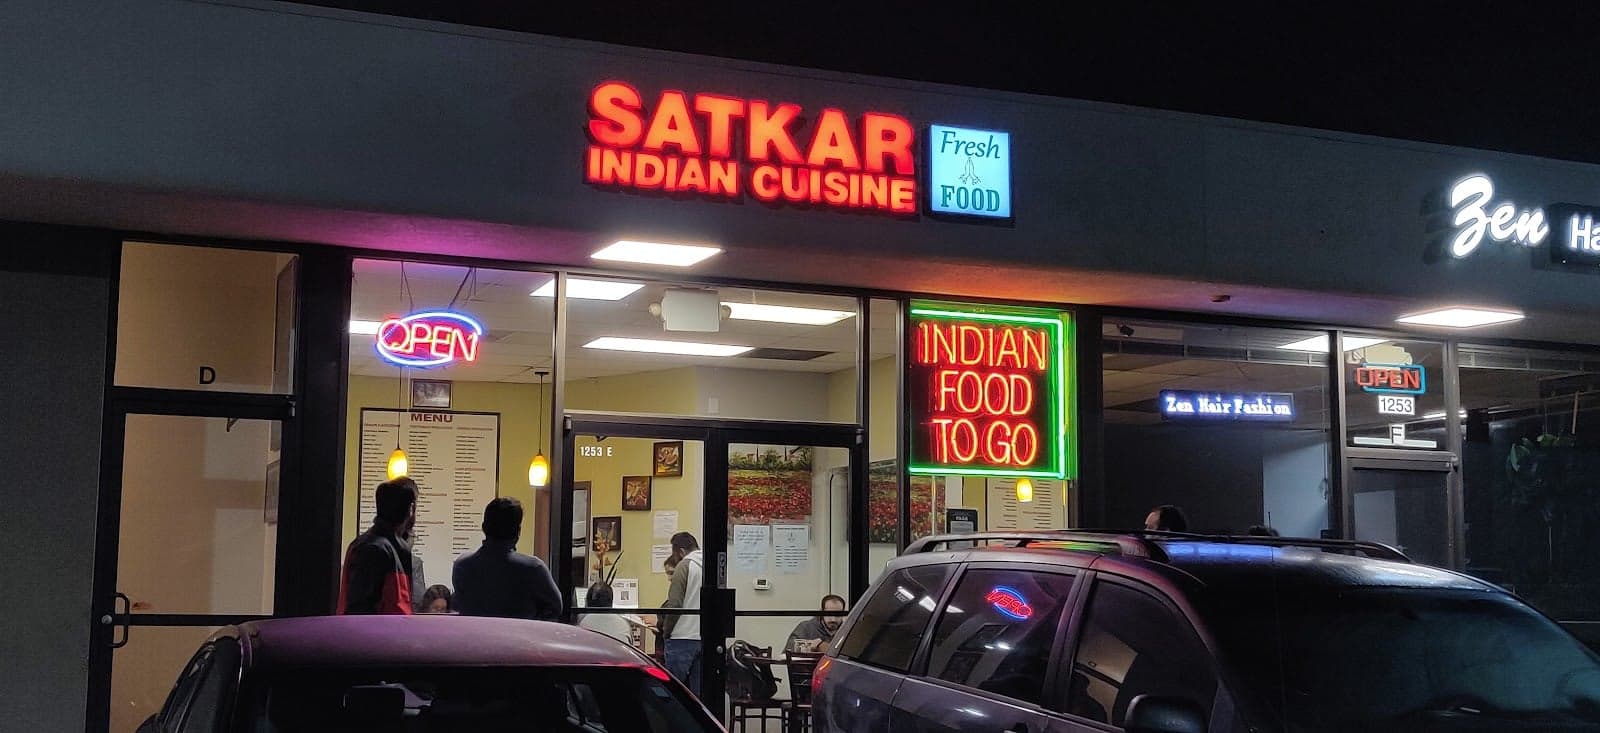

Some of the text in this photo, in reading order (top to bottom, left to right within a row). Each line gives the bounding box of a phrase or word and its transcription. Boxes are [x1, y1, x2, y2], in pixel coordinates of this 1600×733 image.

[589, 82, 915, 175] SATKAR
[940, 130, 1000, 159] Fresh
[588, 147, 916, 213] INDIAN CUISINE
[940, 184, 1001, 212] FOOD
[1451, 175, 1549, 258] Zen
[379, 319, 479, 361] OPEN
[918, 321, 1047, 371] INDIAN
[199, 366, 216, 385] D
[1356, 367, 1420, 389] OPEN
[939, 370, 1033, 416] FOOD
[1166, 396, 1292, 415] Zen Hair Fashion
[1380, 397, 1413, 413] 1253
[410, 412, 454, 423] MENU
[580, 446, 613, 457] 1253 E
[931, 418, 1038, 466] TO GO
